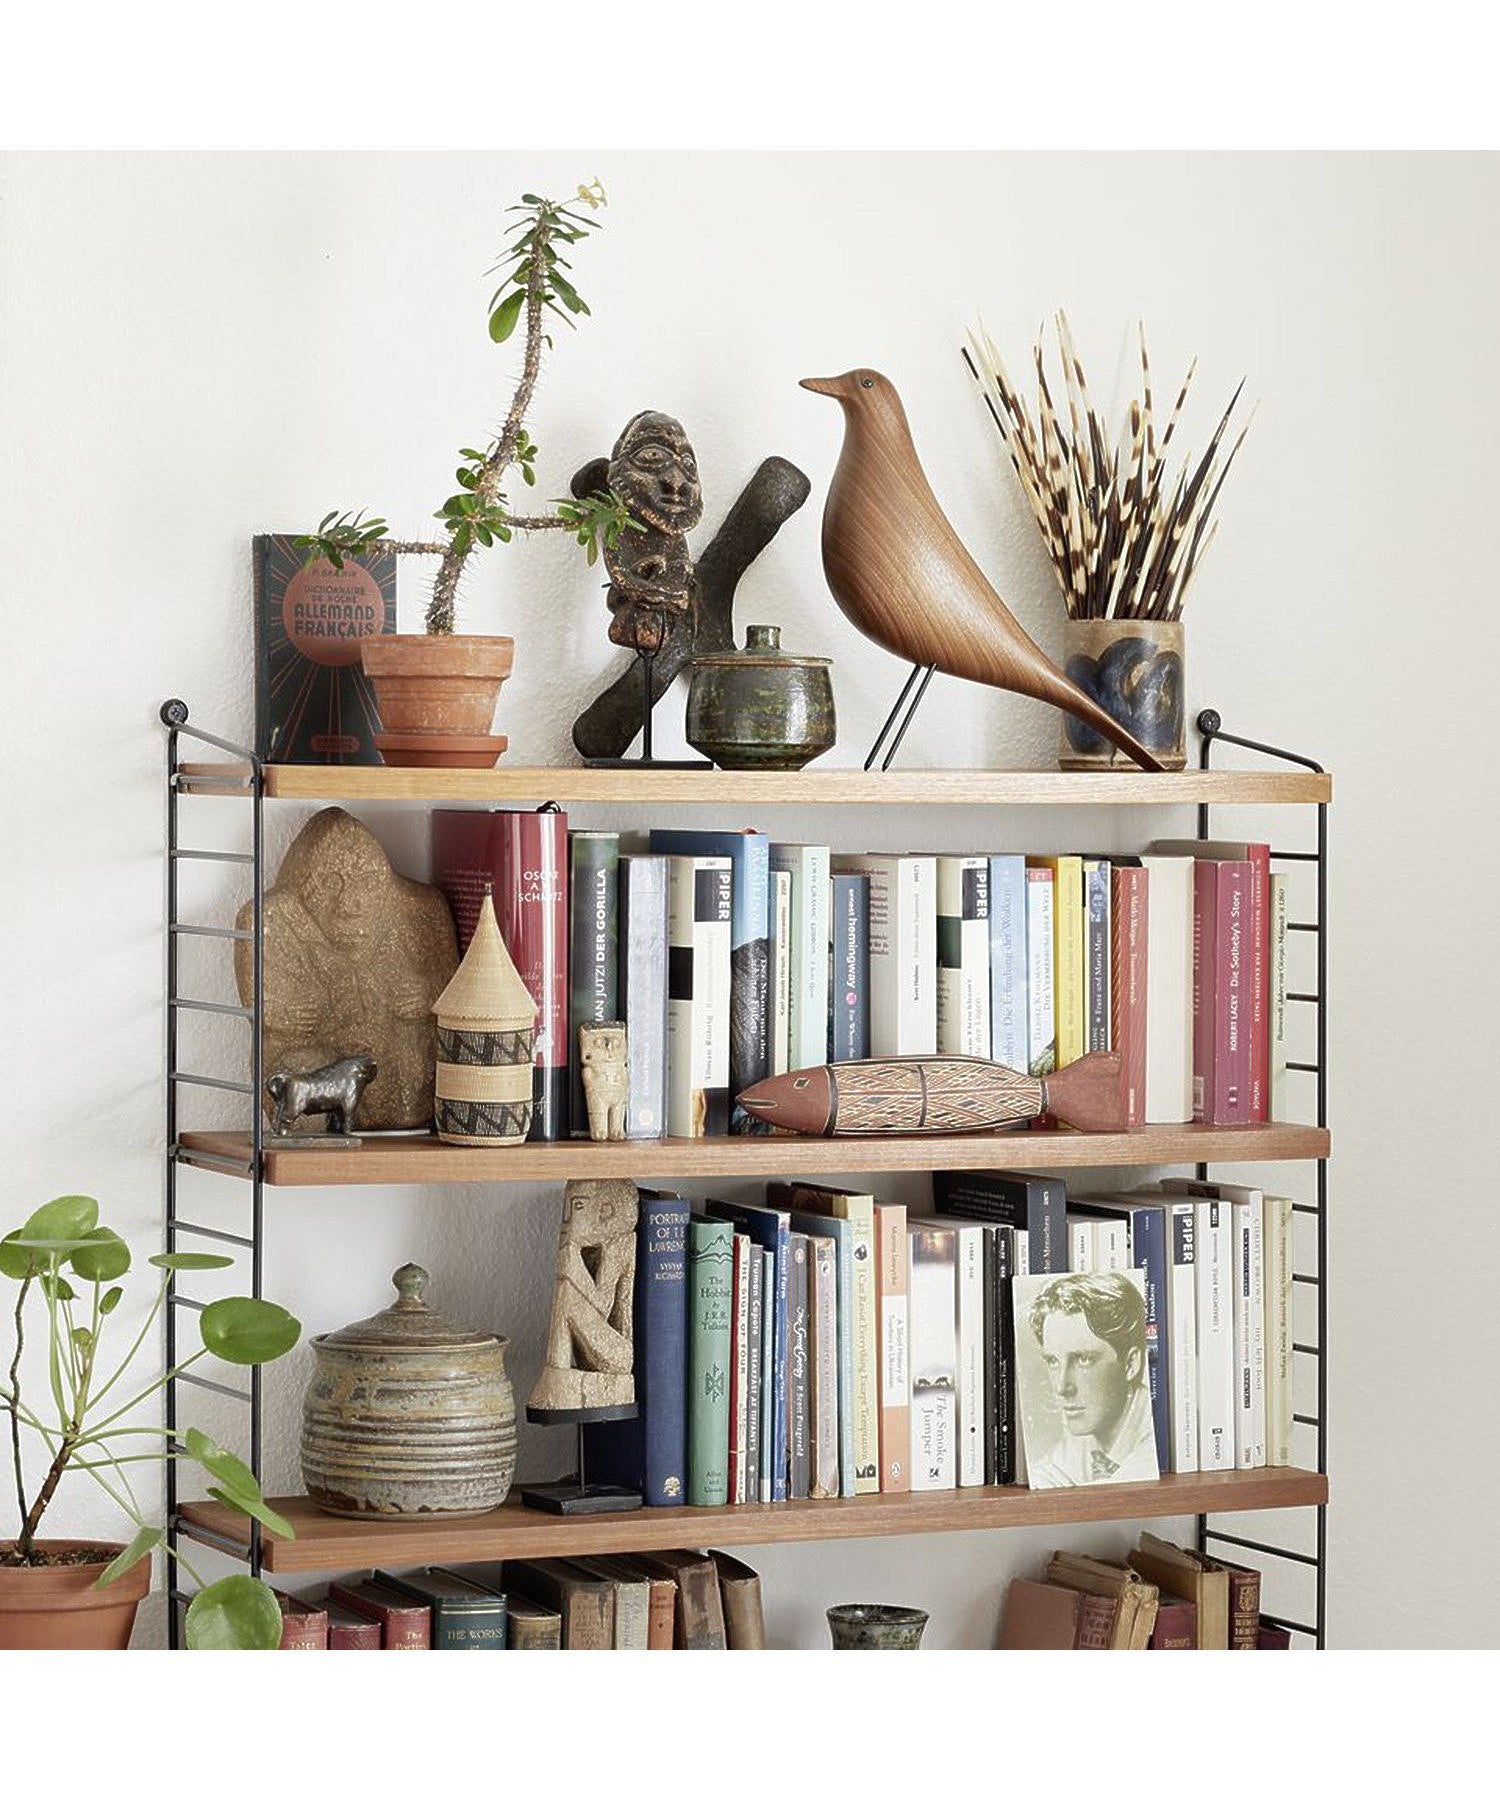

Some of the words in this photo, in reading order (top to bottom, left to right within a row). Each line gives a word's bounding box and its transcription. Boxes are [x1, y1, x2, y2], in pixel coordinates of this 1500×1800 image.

[294, 603, 375, 620] ALLEMAND
[294, 620, 375, 638] FRANÇAIS
[596, 869, 607, 929] GORILLA
[718, 874, 731, 920] PIPER
[976, 873, 987, 918] PIPER
[1232, 890, 1242, 918] Story
[596, 931, 606, 962] DER
[846, 918, 859, 989] hemingway
[1231, 922, 1241, 969] Sotheby's
[594, 965, 606, 998] JUTZI
[1231, 971, 1239, 987] Die
[1230, 994, 1239, 1019] LACEY
[1182, 1218, 1193, 1262] PIPER
[780, 1245, 789, 1275] Animal
[700, 1287, 731, 1298] Hobbit
[707, 1276, 723, 1285] The
[752, 1258, 761, 1297] Truman
[780, 1276, 789, 1299] Farm
[740, 1325, 747, 1338] OF
[751, 1299, 760, 1335] Capote
[739, 1342, 747, 1375] FOUR
[750, 1348, 758, 1394] BREAKFAST
[750, 1396, 757, 1407] AT
[936, 1396, 948, 1418] The
[749, 1409, 757, 1452] TIFFANY'S
[921, 1407, 935, 1455] Jumper
[936, 1421, 948, 1464] Smoke
[406, 1631, 423, 1640] The
[448, 1629, 467, 1641] THE
[468, 1627, 504, 1639] WORKS
